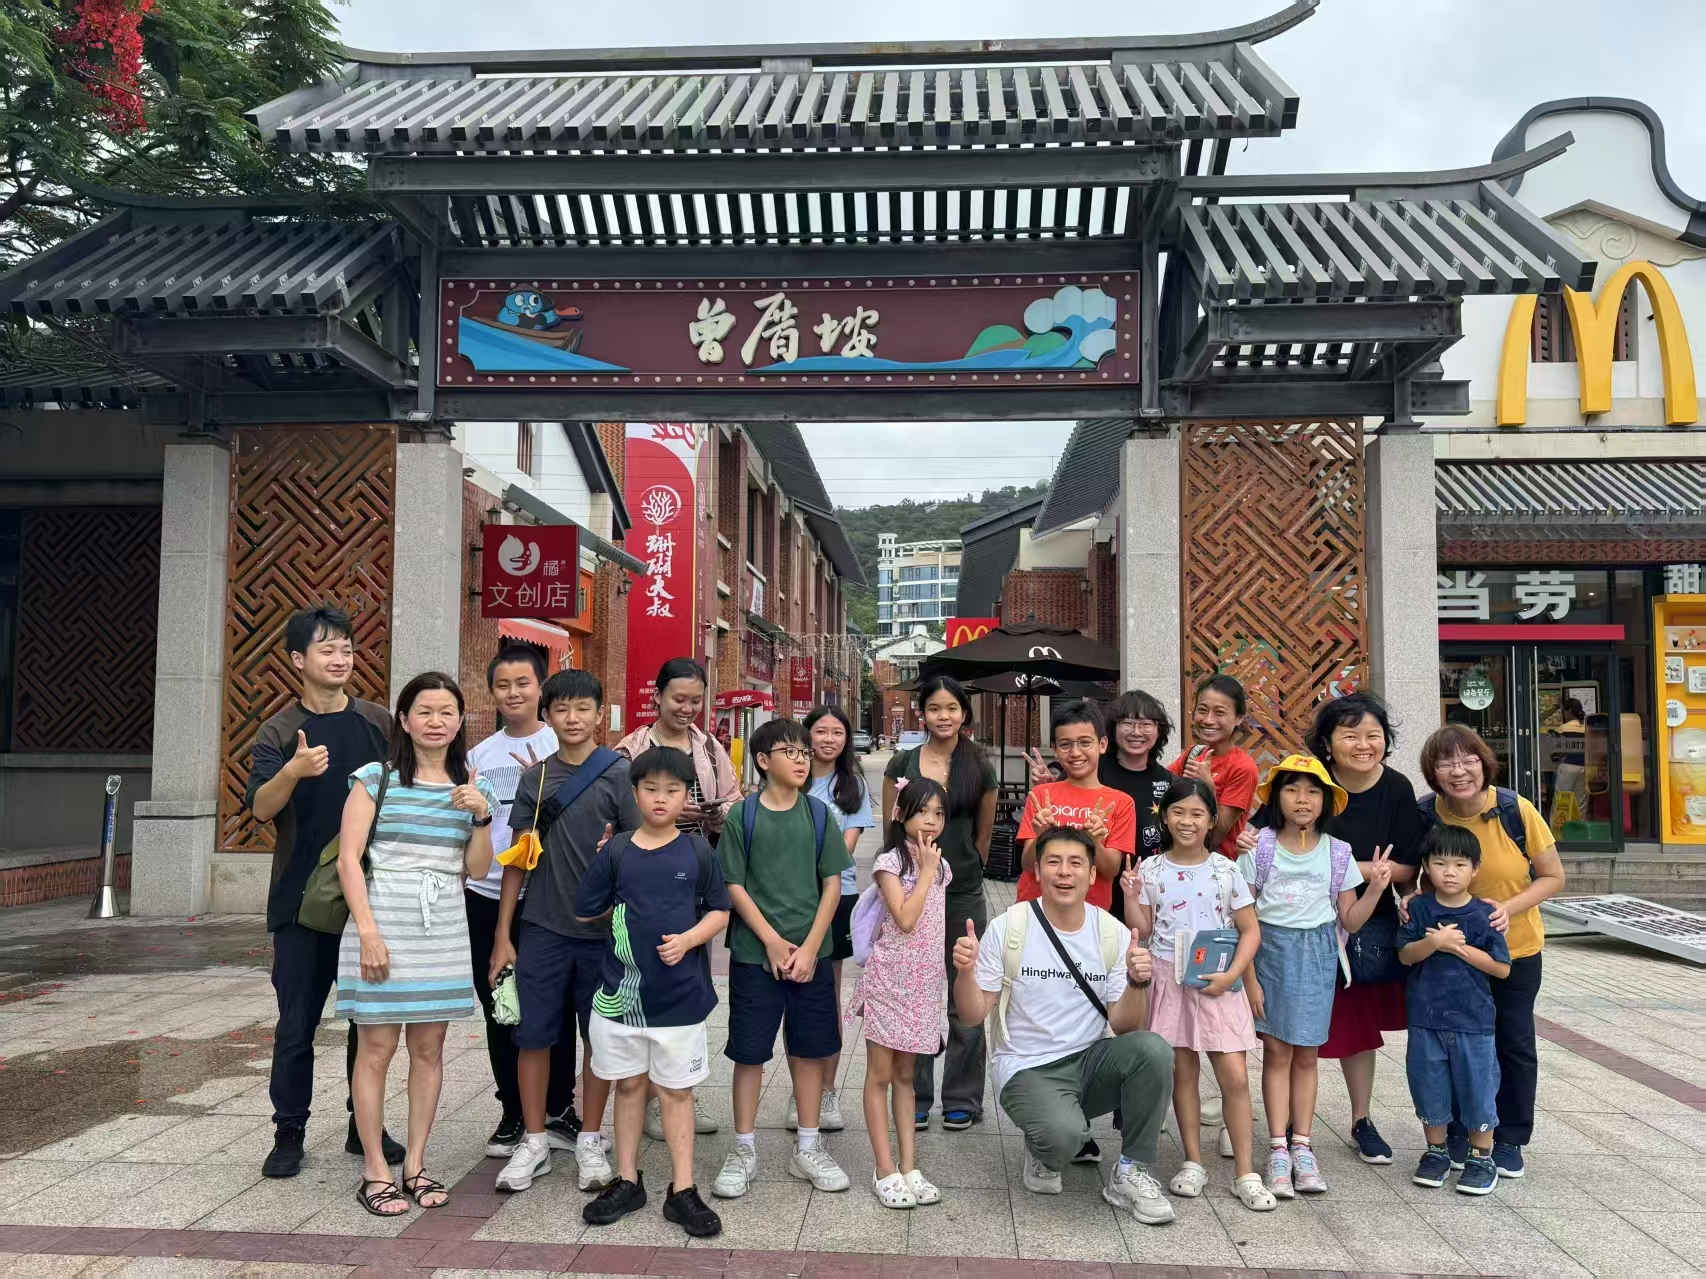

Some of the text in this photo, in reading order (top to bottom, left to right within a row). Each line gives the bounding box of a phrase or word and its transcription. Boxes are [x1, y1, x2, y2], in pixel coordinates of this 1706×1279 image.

[688, 292, 880, 367] 曾厝垵
[487, 581, 571, 608] 文创店
[644, 532, 677, 618] 珊瑚大叔
[1021, 966, 1072, 980] HingHwa
